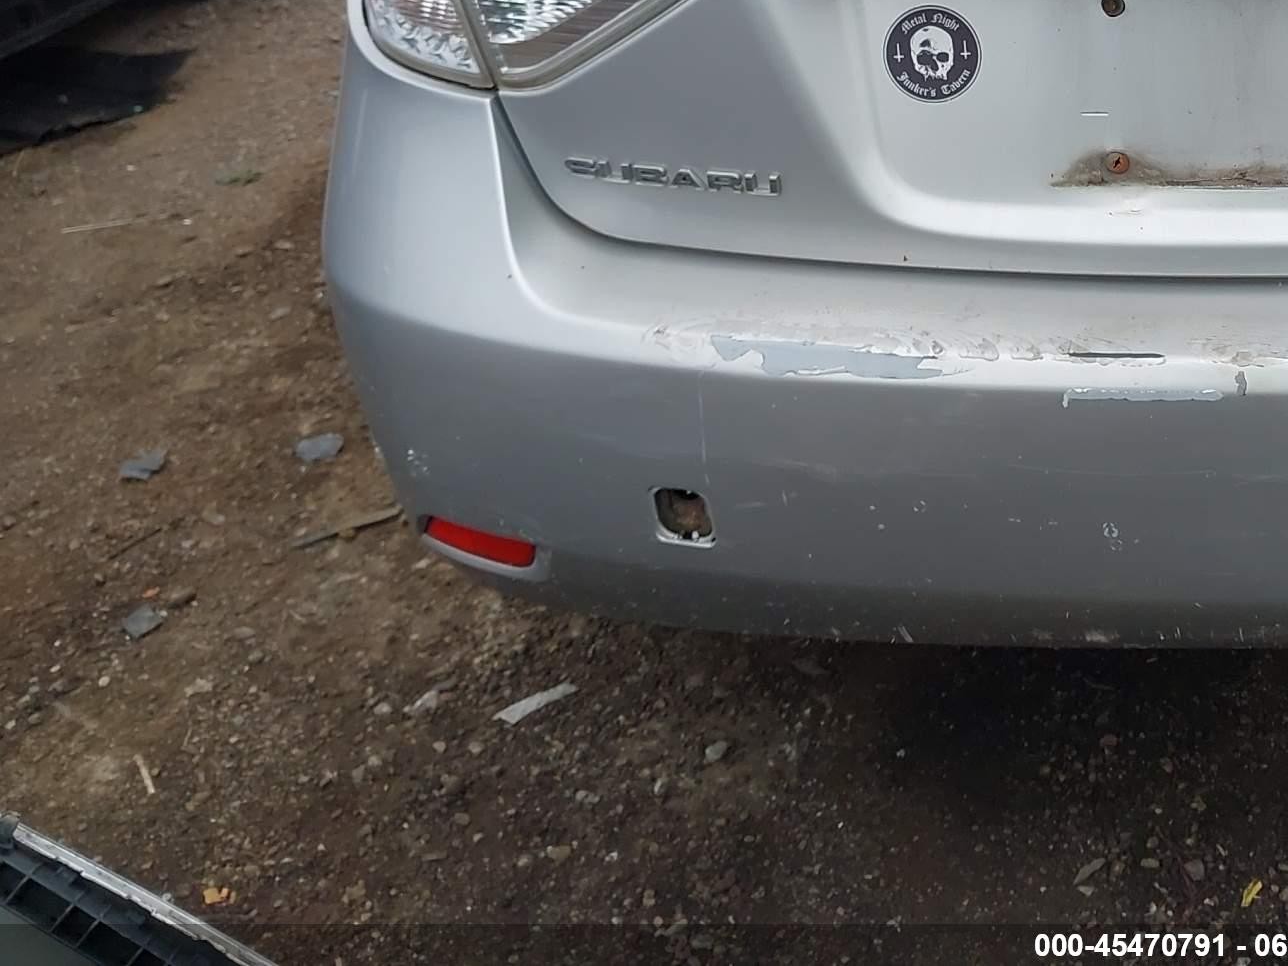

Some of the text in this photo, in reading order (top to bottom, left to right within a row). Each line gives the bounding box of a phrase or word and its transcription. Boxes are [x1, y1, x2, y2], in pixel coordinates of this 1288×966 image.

[902, 13, 960, 34] Metal Night
[941, 69, 971, 94] Tavern
[564, 156, 782, 196] SUBARU
